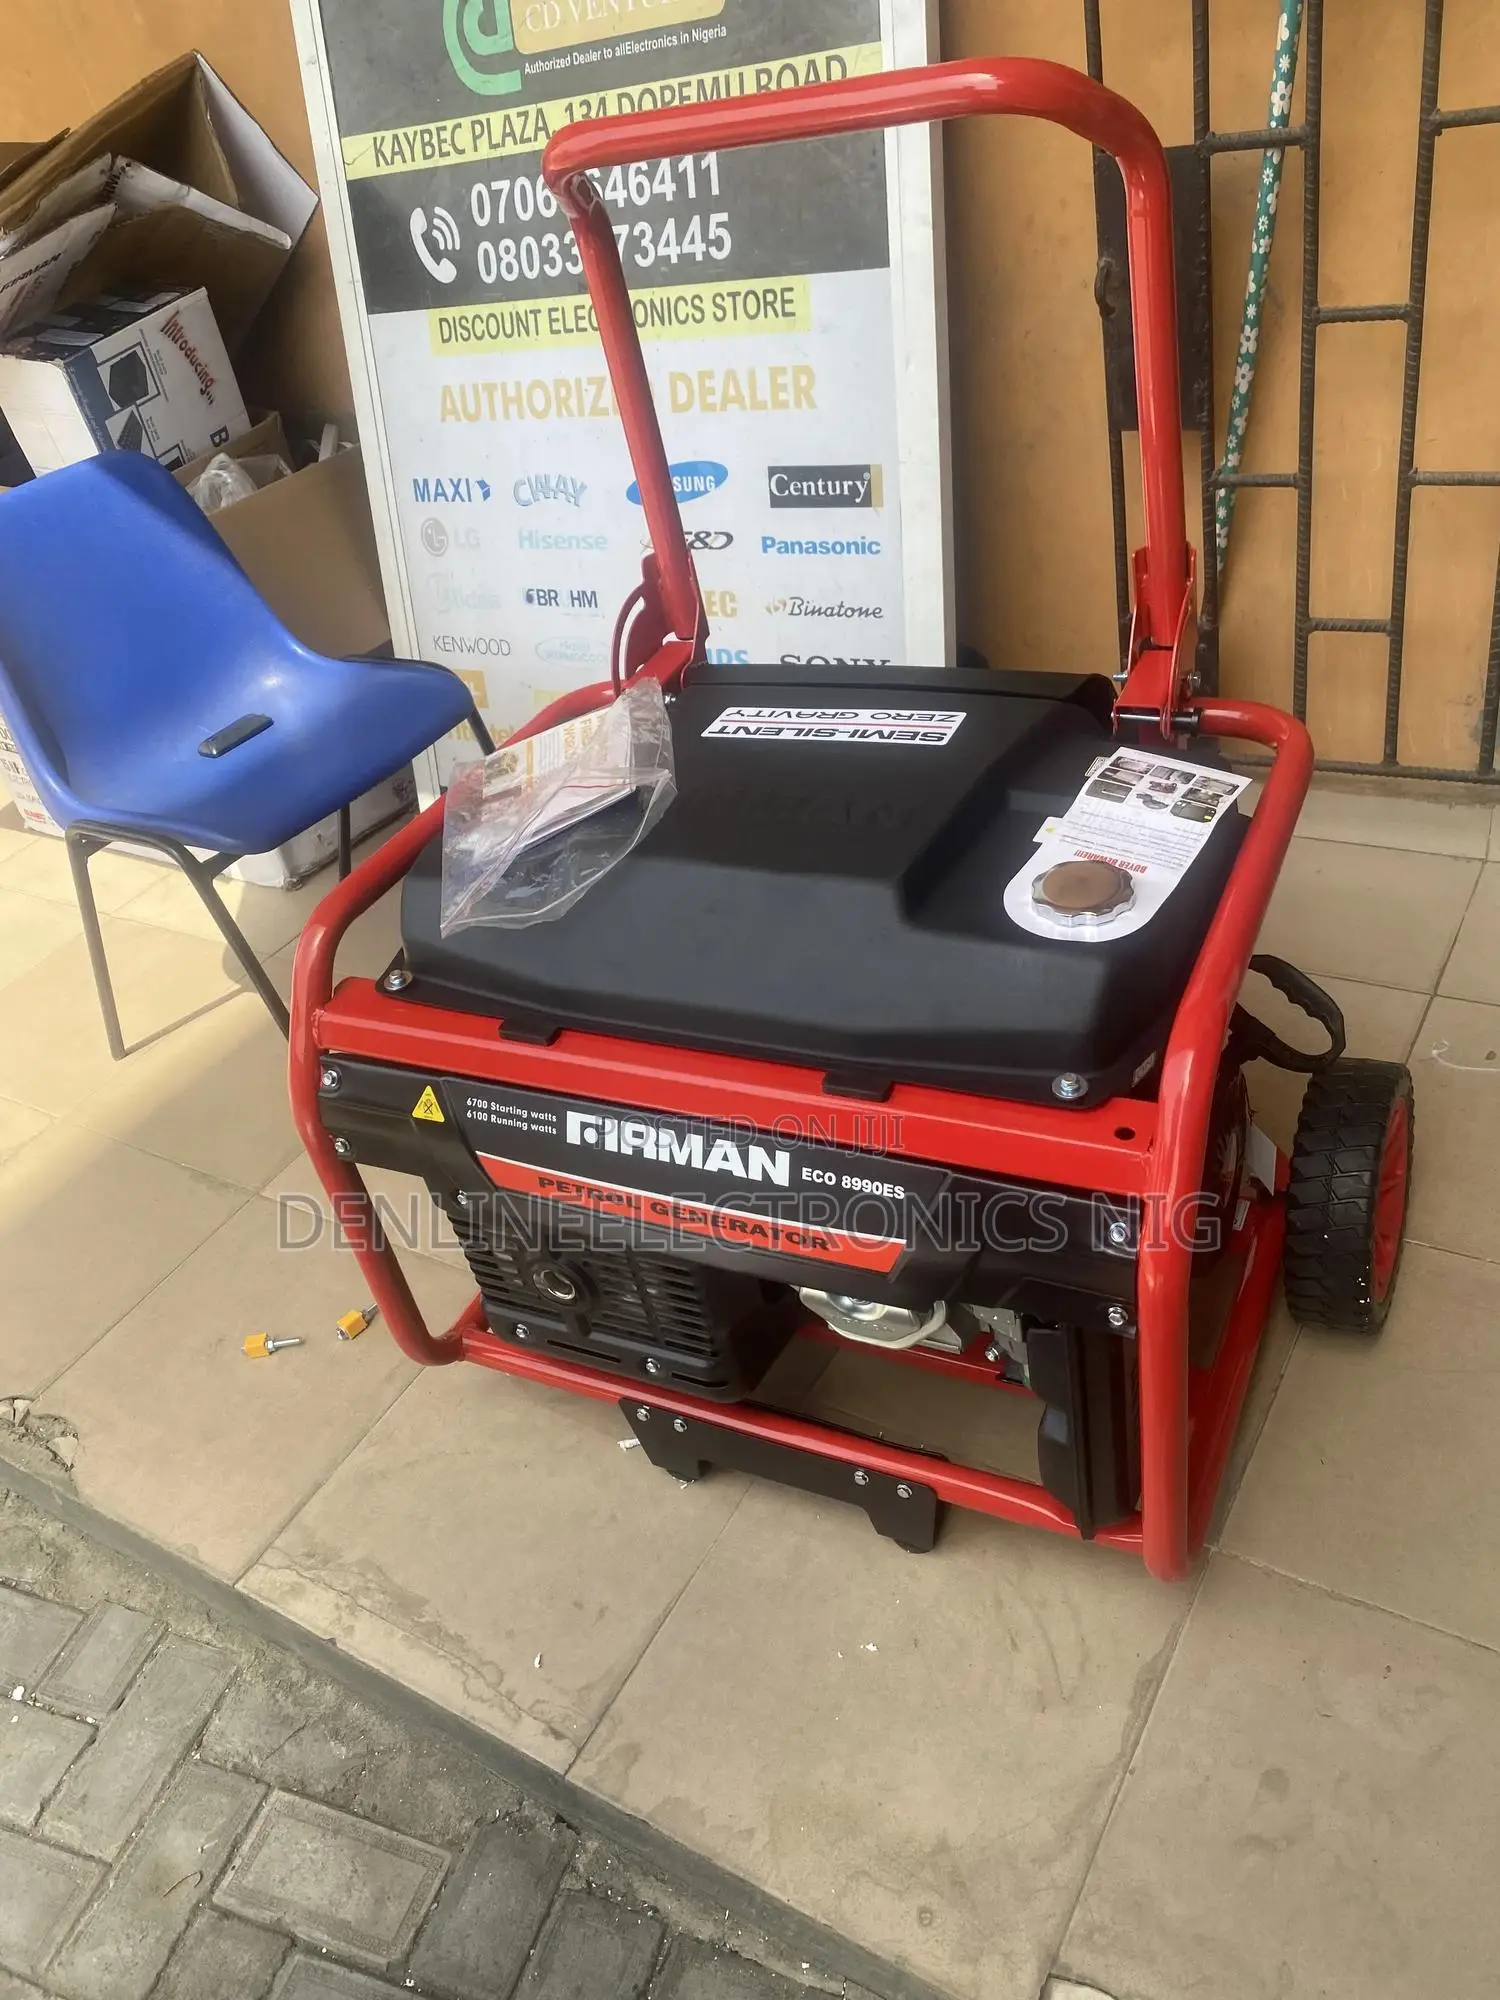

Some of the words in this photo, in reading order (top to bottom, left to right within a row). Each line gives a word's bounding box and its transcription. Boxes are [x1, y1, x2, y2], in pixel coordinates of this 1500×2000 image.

[524, 54, 571, 75] Authorized
[573, 49, 602, 66] Dealer
[603, 46, 613, 59] to
[680, 31, 689, 44] in
[691, 24, 727, 43] Nigeria
[373, 122, 466, 168] KAYBEC
[755, 54, 848, 94] ROAD
[477, 212, 732, 284] 0803373445
[438, 307, 541, 344] DISCOUNT
[548, 294, 706, 336] ELECONICS
[712, 286, 797, 323] STORE
[440, 375, 656, 424] AUTHORIZ
[668, 363, 818, 414] DEALER
[412, 478, 472, 503] MAXI
[673, 475, 716, 493] SUNG
[769, 472, 870, 504] Century
[517, 529, 608, 551] Hisense
[760, 535, 882, 556] Panasonic
[535, 587, 599, 609] BRHM
[788, 596, 884, 620] Binatone
[432, 634, 512, 657] KENWOOD
[726, 708, 860, 721] GRAVITY
[869, 711, 961, 723] ZERO
[707, 724, 949, 743] SEMI-SILENT
[1119, 860, 1148, 874] BUYER
[466, 1097, 488, 1110] 6700
[490, 1101, 528, 1119] Starting
[530, 1109, 557, 1122] watts
[466, 1110, 488, 1123] 6100
[490, 1114, 528, 1131] Running
[530, 1122, 557, 1135] watts
[566, 1110, 790, 1187] FIRMAN
[800, 1166, 837, 1188] ECO
[841, 1174, 906, 1201] 8990ES
[537, 1175, 641, 1209] PETROL
[649, 1197, 832, 1253] GENERATOR
